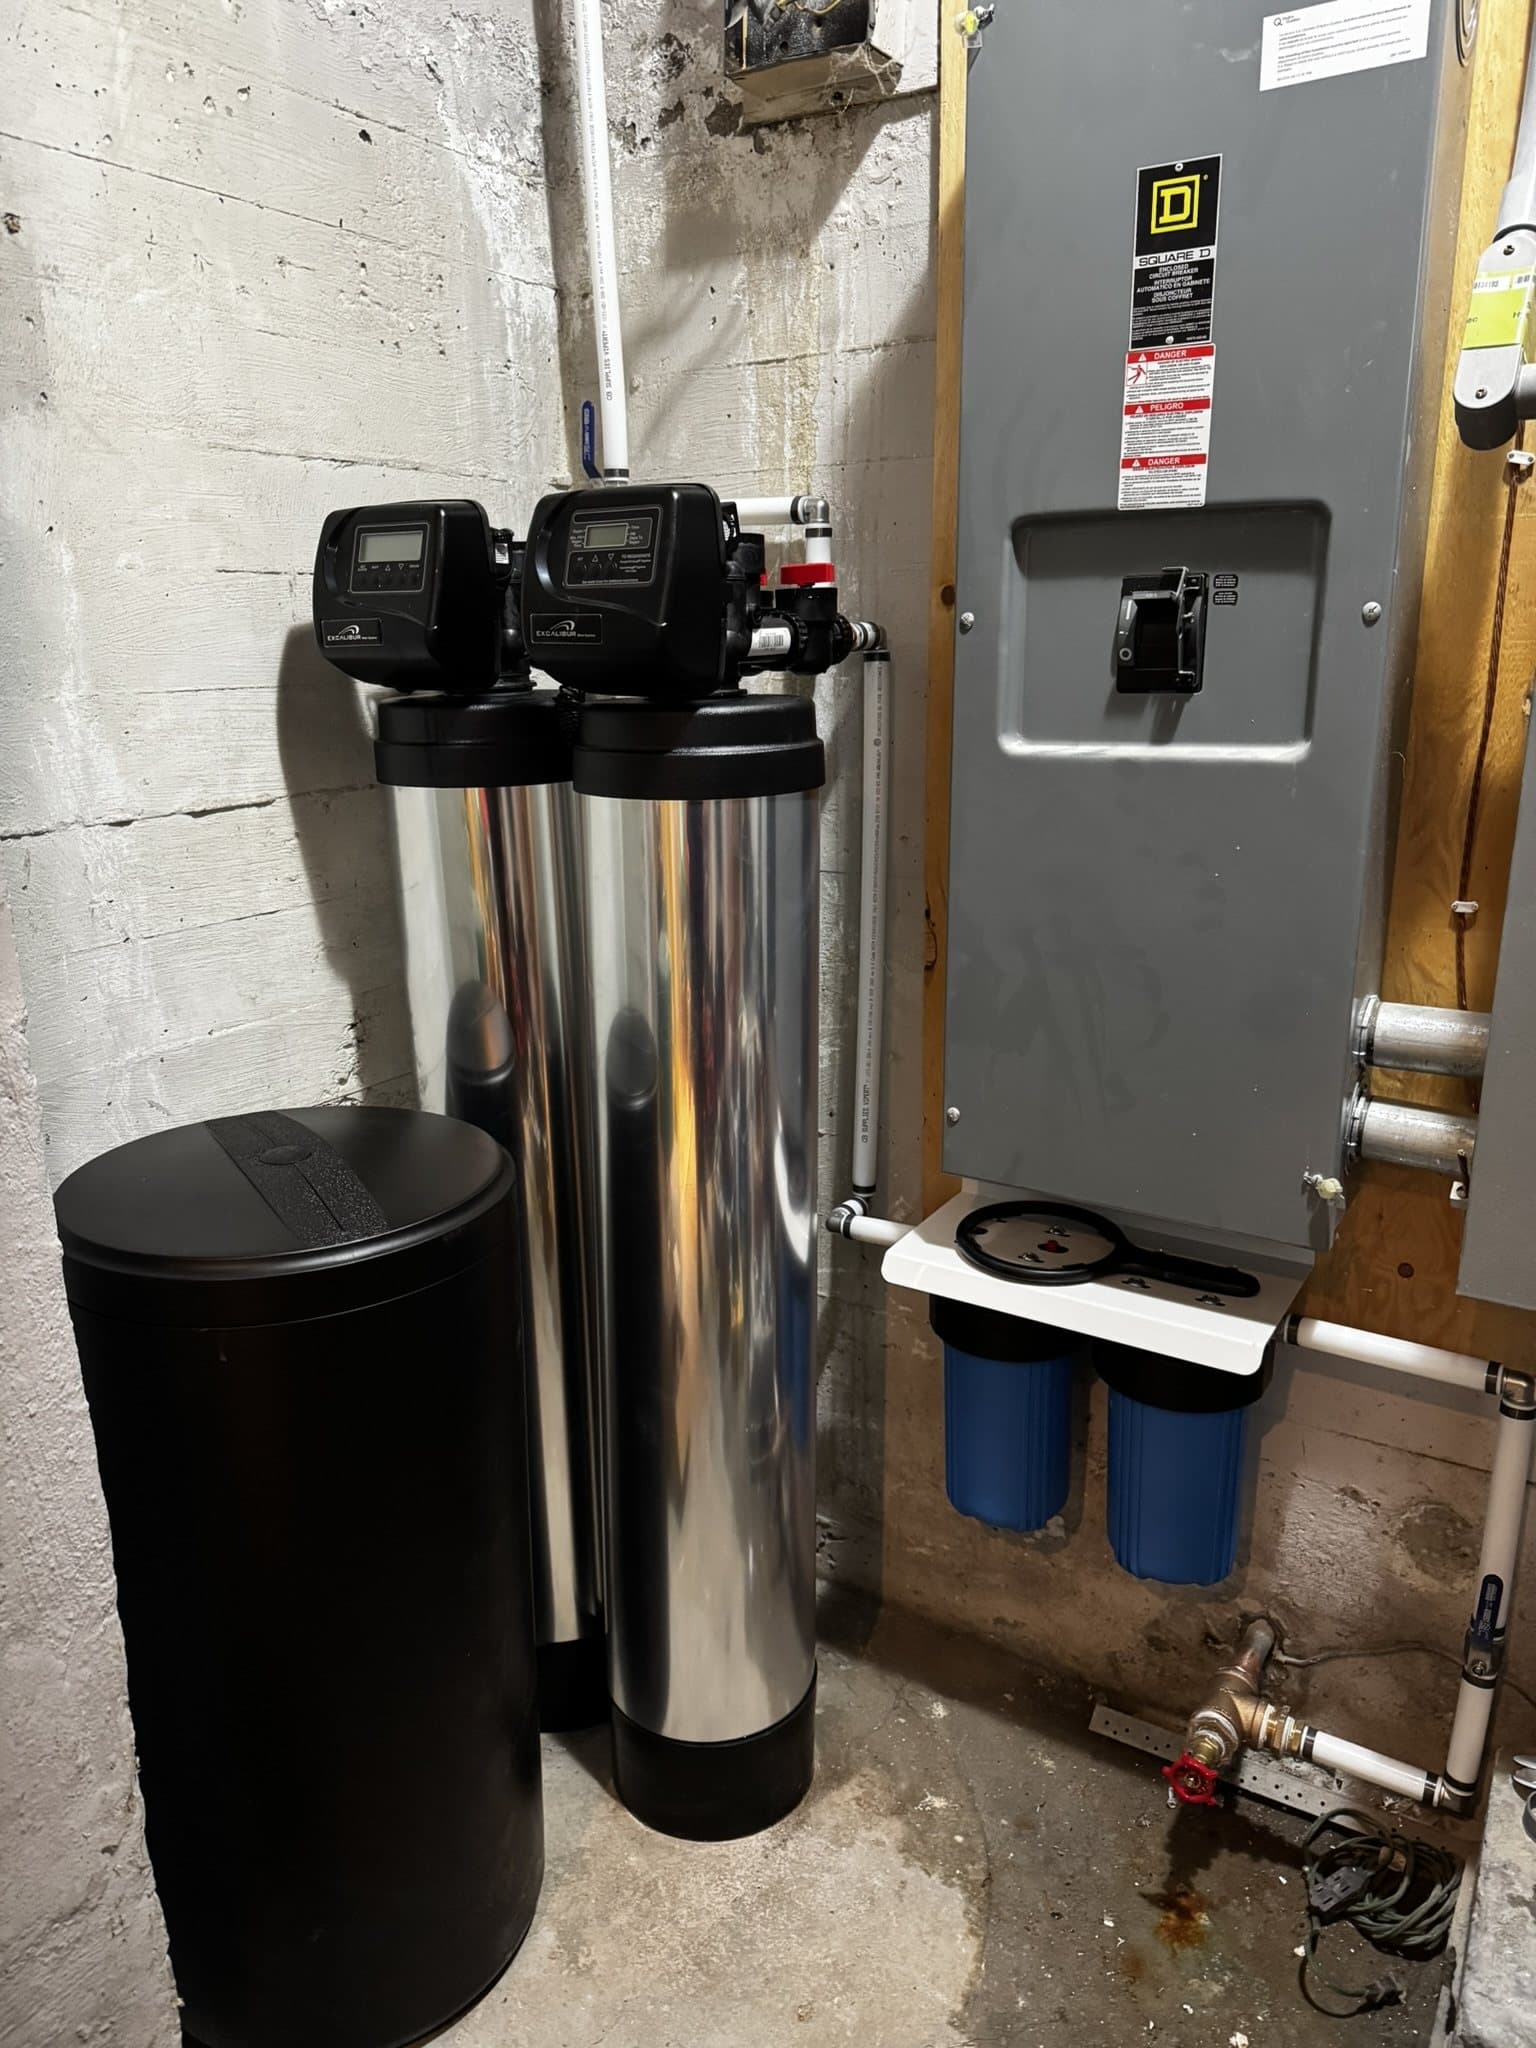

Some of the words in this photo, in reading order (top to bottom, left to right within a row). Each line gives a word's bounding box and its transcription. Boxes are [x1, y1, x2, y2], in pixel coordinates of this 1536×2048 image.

[1139, 250, 1194, 267] SQUARE
[1199, 248, 1211, 258] D
[1159, 263, 1189, 272] ENCLOSED
[1149, 271, 1171, 279] CIRCUIT
[1171, 267, 1199, 276] BREAKER
[1153, 275, 1193, 285] INTERRUPTOR
[1182, 278, 1210, 287] GABINETE
[1153, 287, 1192, 298] DISJONCTEUR
[1167, 293, 1193, 301] COFFRET
[1153, 350, 1187, 360] DANGER
[604, 358, 612, 388] SUPPLIES
[1150, 402, 1184, 411] PELIGRO
[1147, 457, 1181, 466] DANGER
[862, 1107, 870, 1133] SUPPLIES
